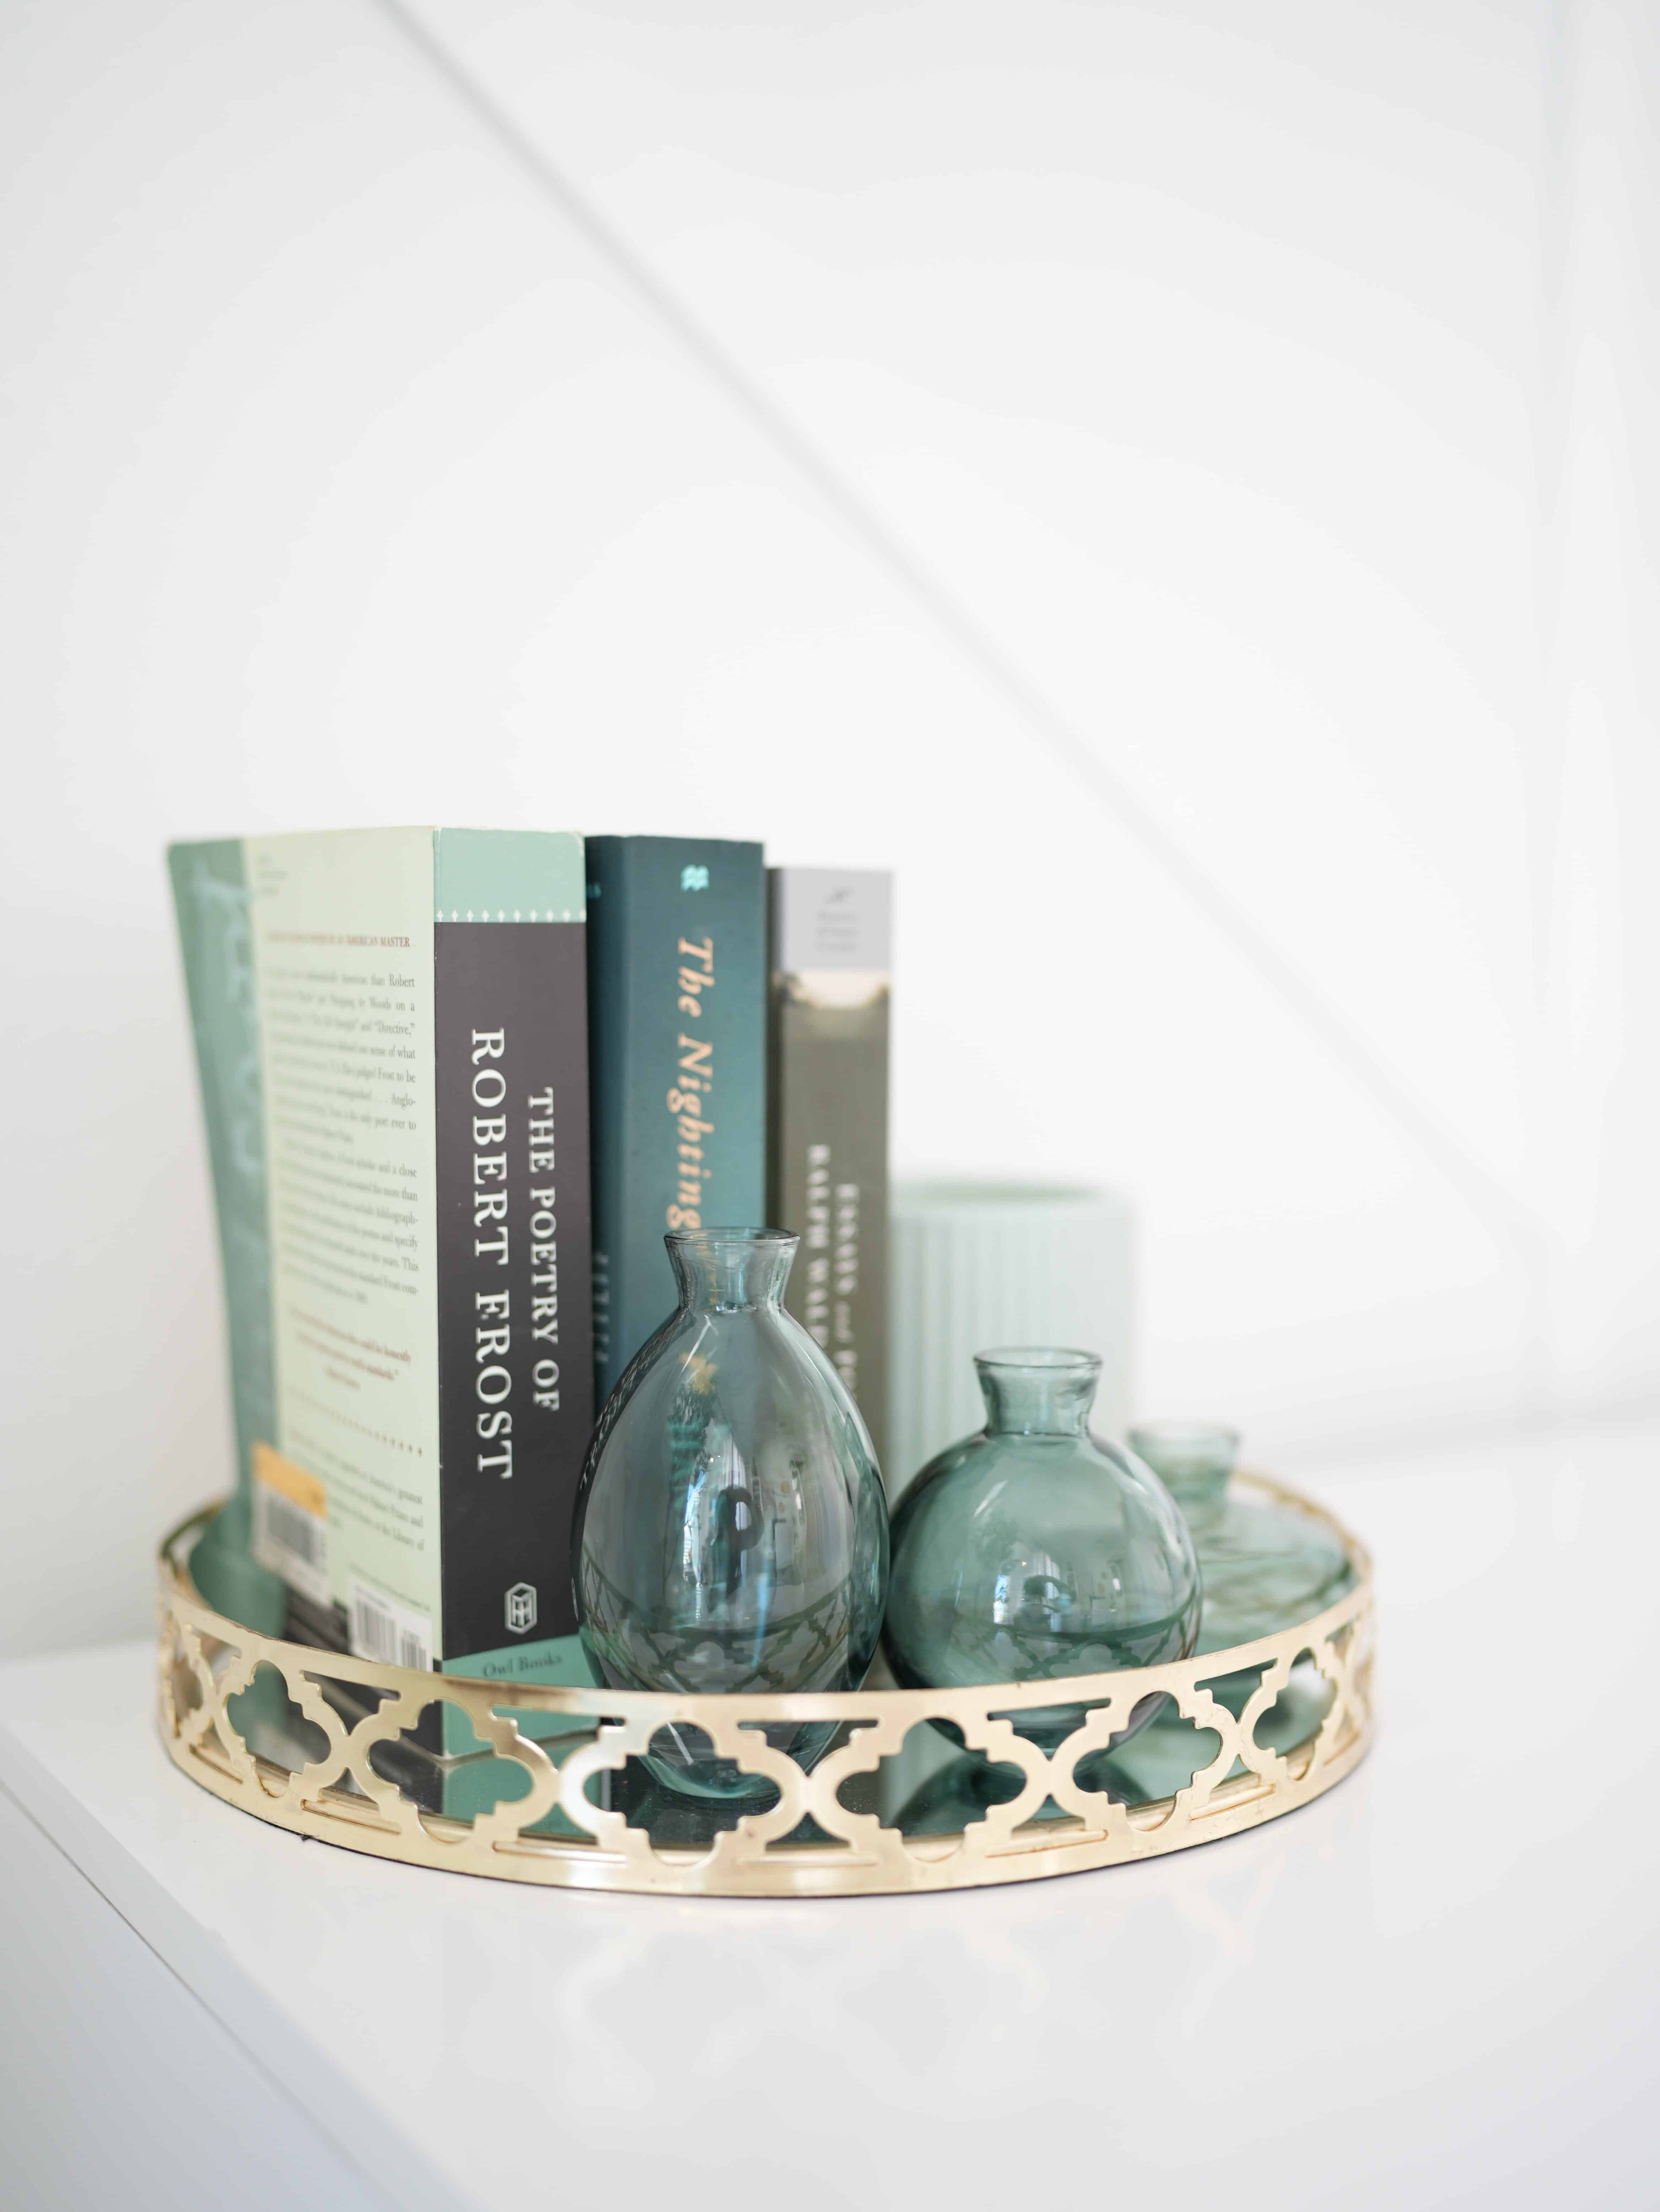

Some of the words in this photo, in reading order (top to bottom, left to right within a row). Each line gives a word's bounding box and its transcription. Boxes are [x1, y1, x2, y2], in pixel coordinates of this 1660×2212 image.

[381, 935, 410, 947] MASTER
[389, 973, 415, 987] Robert
[678, 936, 715, 1018] The
[396, 1002, 405, 1011] on
[410, 1002, 415, 1011] a
[389, 1043, 397, 1057] of
[398, 1045, 415, 1059] what
[397, 1071, 404, 1081] to
[407, 1069, 416, 1083] be
[392, 1092, 416, 1110] Anglo-
[391, 1118, 405, 1129] ever
[409, 1121, 416, 1130] to
[528, 1086, 556, 1173] THE
[666, 1032, 715, 1230] Nighting
[471, 1027, 509, 1266] ROBERT
[399, 1163, 417, 1177] close
[402, 1186, 417, 1202] than
[807, 1144, 831, 1249] RALPH
[395, 1234, 418, 1252] specify
[401, 1256, 419, 1271] This
[529, 1186, 559, 1345] POETRY
[401, 1284, 419, 1294] com-
[475, 1289, 513, 1480] FROST
[532, 1359, 561, 1412] OF
[483, 1659, 514, 1678] Owl
[519, 1650, 564, 1671] Books
